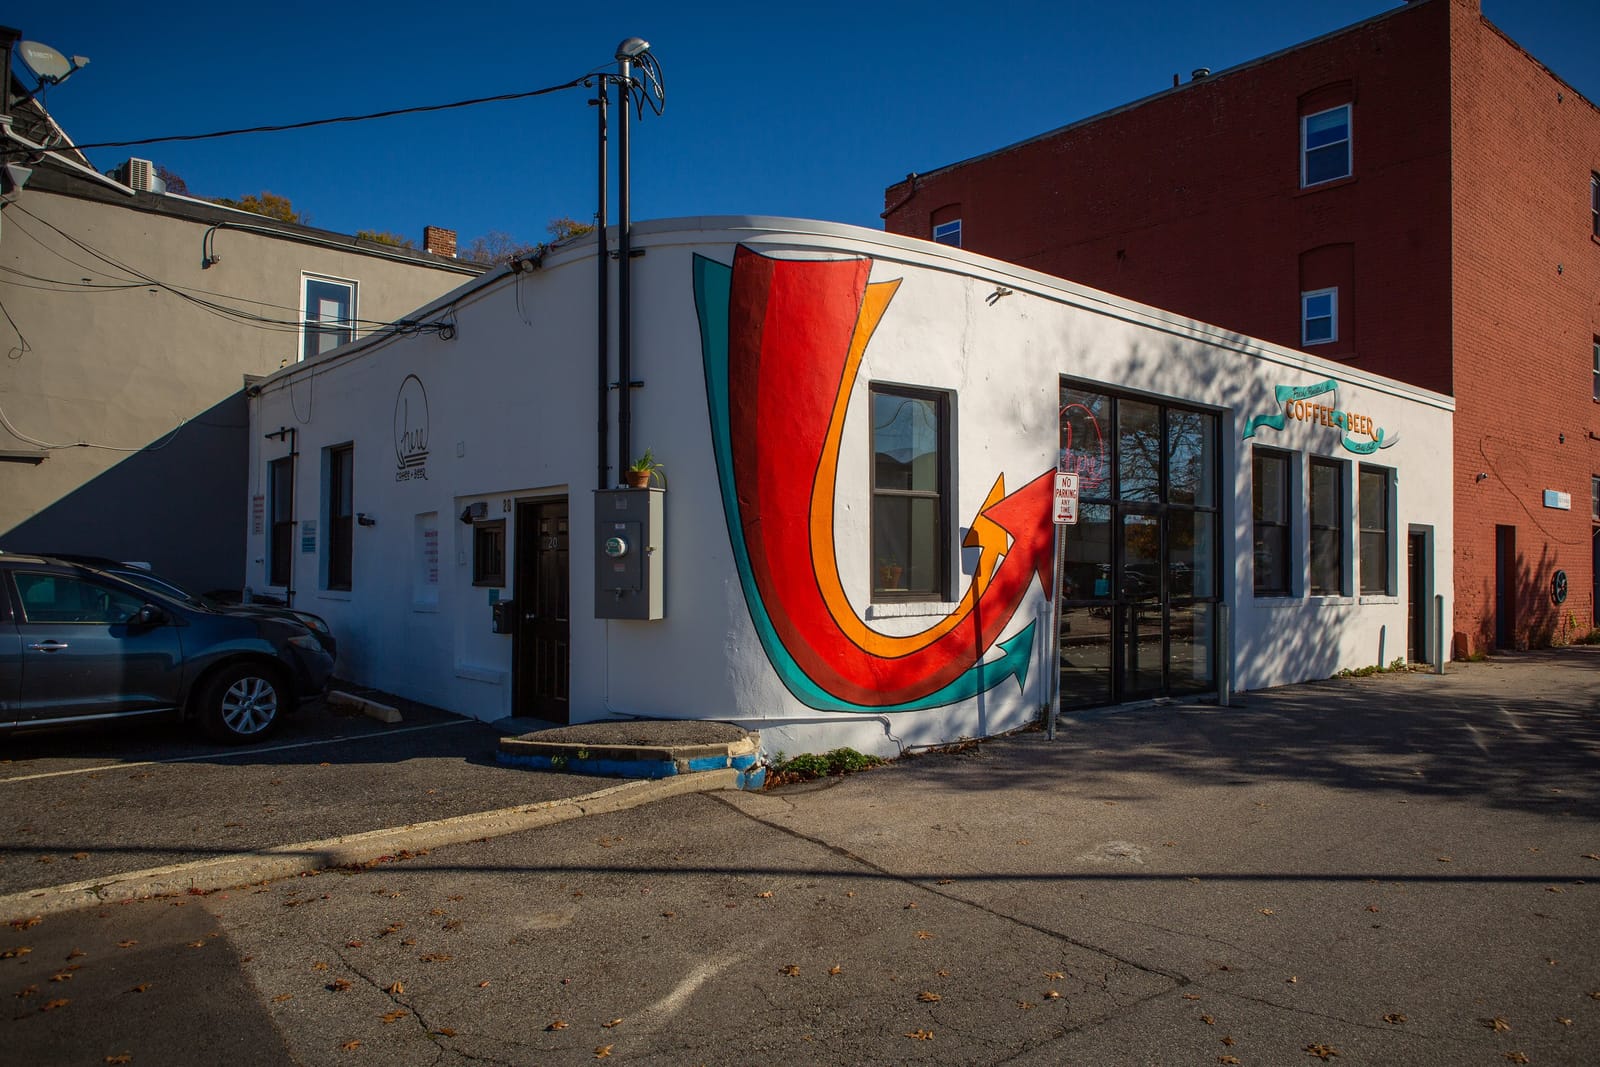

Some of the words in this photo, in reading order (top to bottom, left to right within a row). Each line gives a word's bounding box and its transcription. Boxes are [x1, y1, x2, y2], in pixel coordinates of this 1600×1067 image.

[1286, 398, 1335, 428] COFFEE
[1347, 411, 1378, 442] BEER
[1062, 477, 1072, 488] NO
[1056, 488, 1076, 499] PARKING
[548, 536, 558, 548] 20
